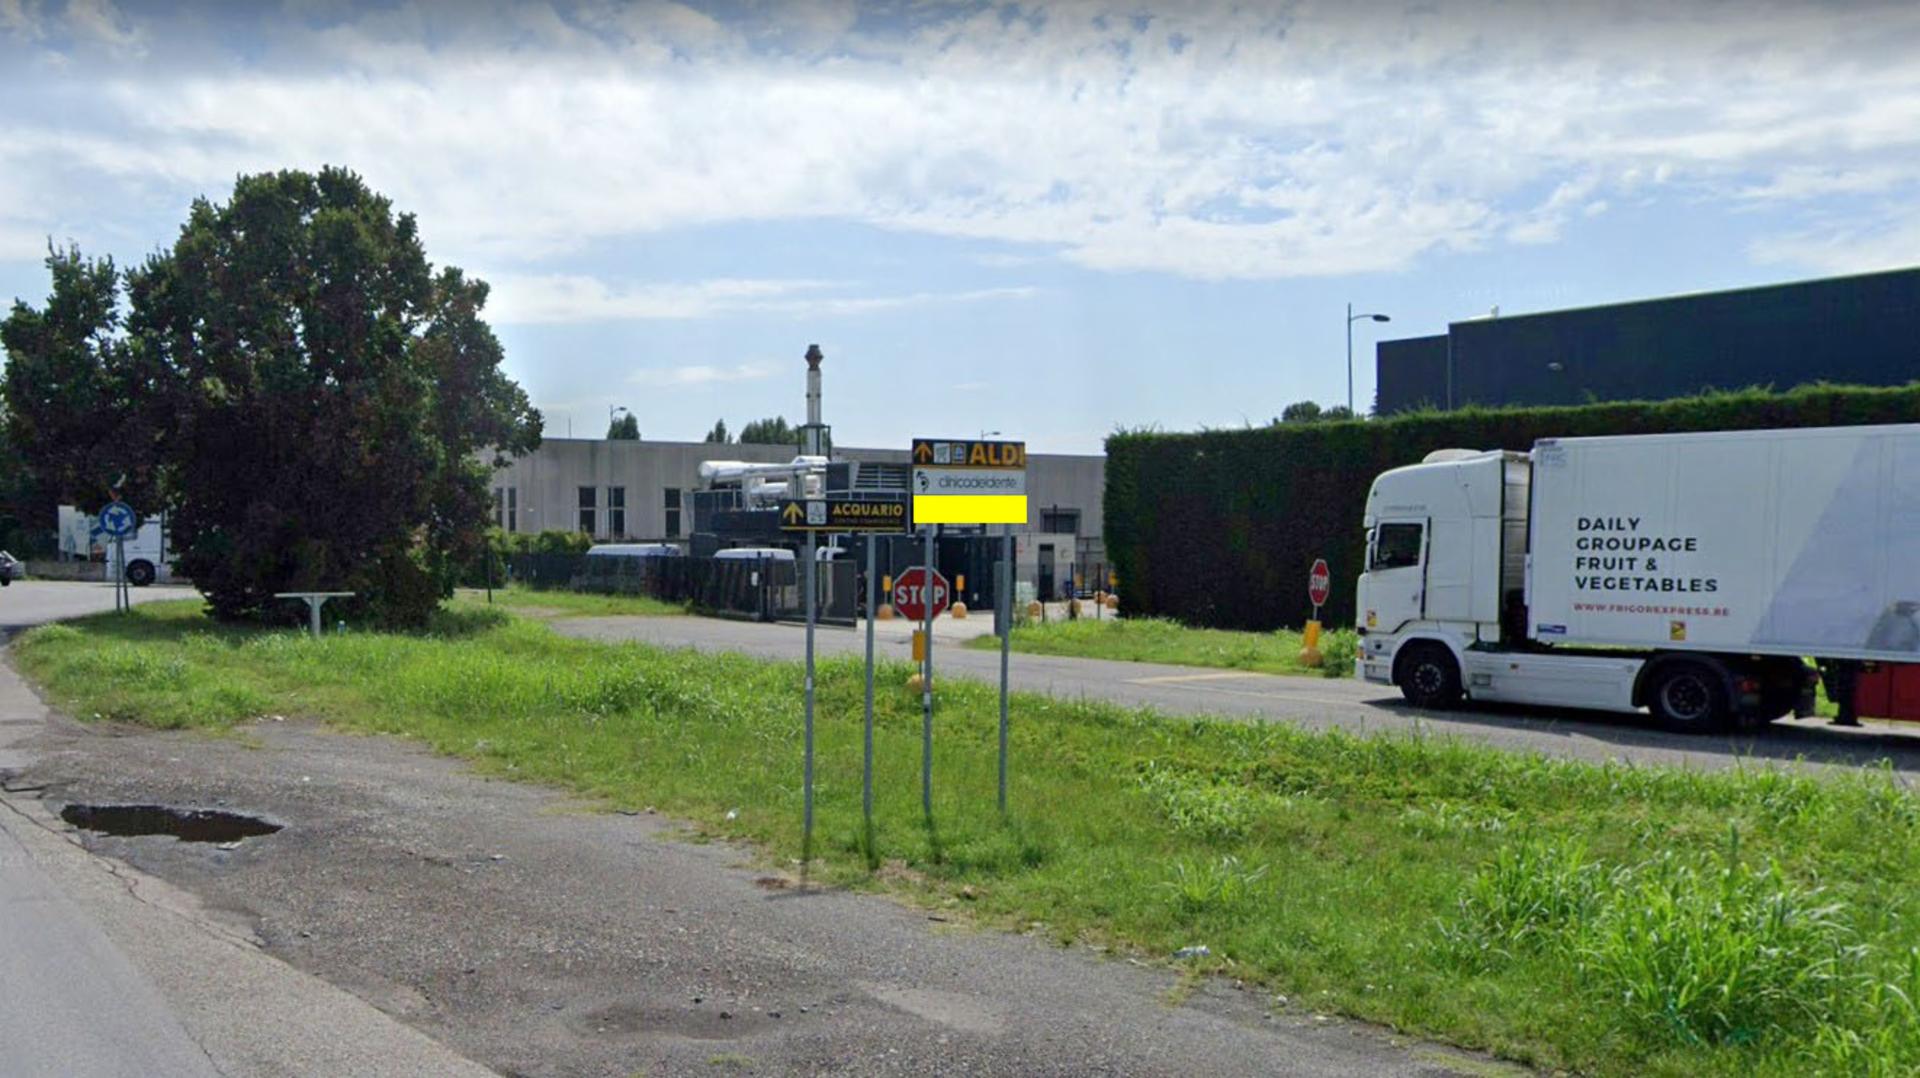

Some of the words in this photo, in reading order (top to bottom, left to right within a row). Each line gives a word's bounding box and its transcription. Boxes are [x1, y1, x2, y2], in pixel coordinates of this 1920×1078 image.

[970, 443, 1024, 465] ALDI
[832, 503, 904, 517] ACQUARIO
[1577, 517, 1641, 531] DAILY
[1576, 537, 1697, 552] GROUPAGE
[1576, 557, 1638, 571] FRUIT
[1645, 557, 1658, 571] &
[1575, 576, 1718, 592] VEGETABLES
